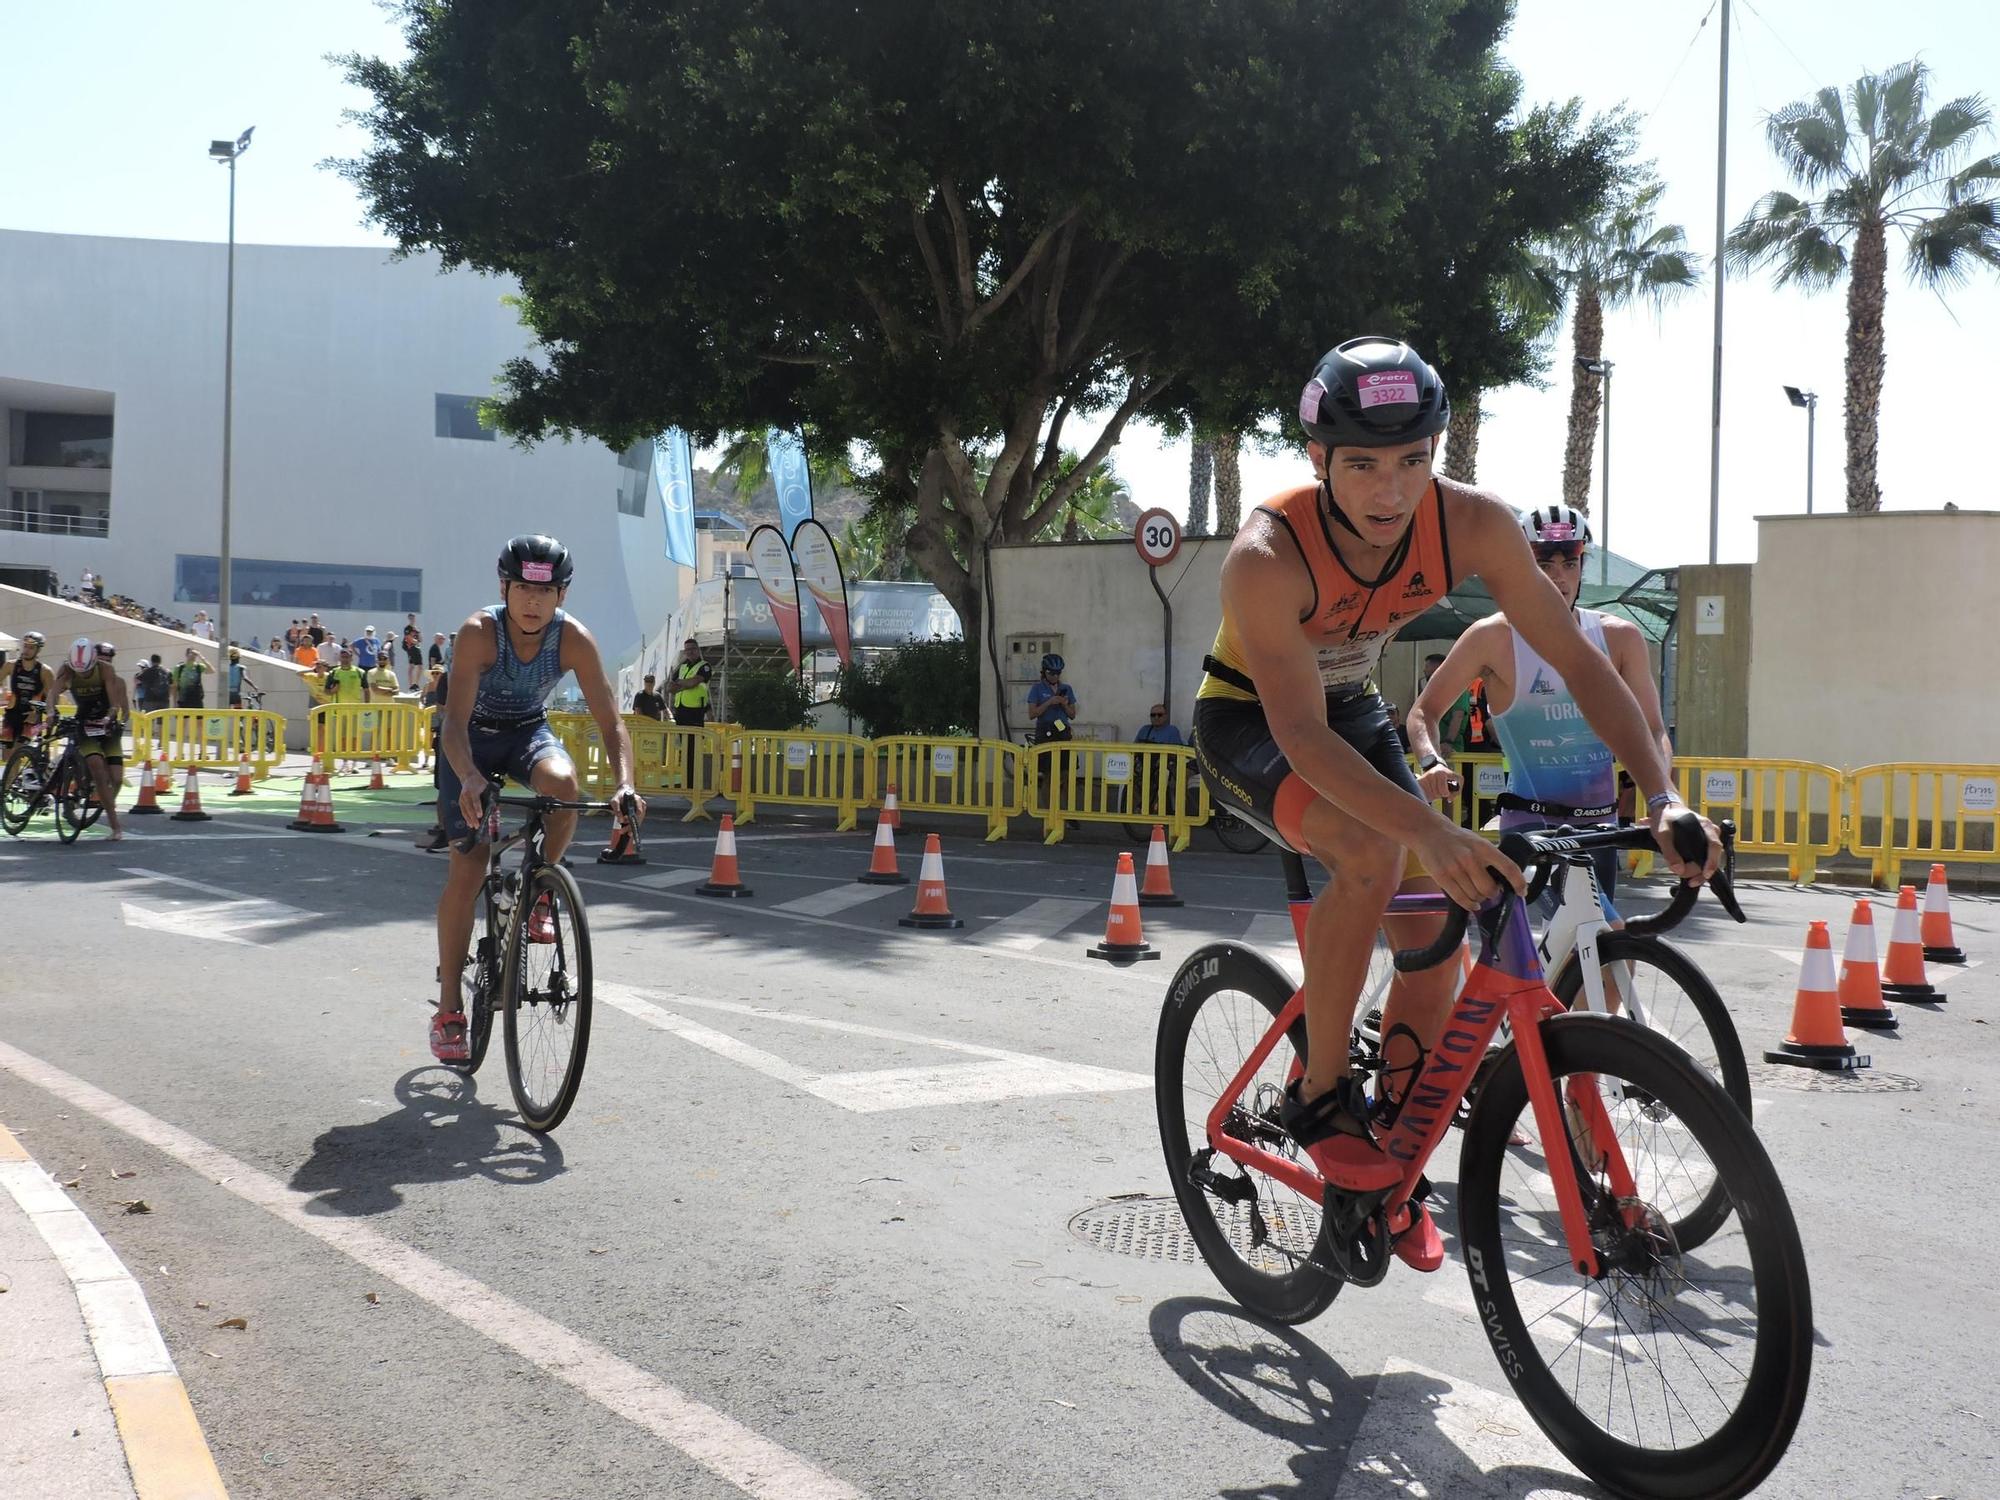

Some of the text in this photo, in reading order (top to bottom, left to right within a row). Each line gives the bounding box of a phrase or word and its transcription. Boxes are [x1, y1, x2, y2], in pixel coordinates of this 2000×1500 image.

[1371, 387, 1406, 404] 3322
[1146, 526, 1172, 548] 30
[868, 608, 914, 617] PATRONATO
[868, 618, 914, 627] DEPORTIVO
[1174, 957, 1219, 1009] DT SWISS
[1388, 996, 1497, 1162] CANYON
[1468, 1245, 1524, 1379] DT SWISS
